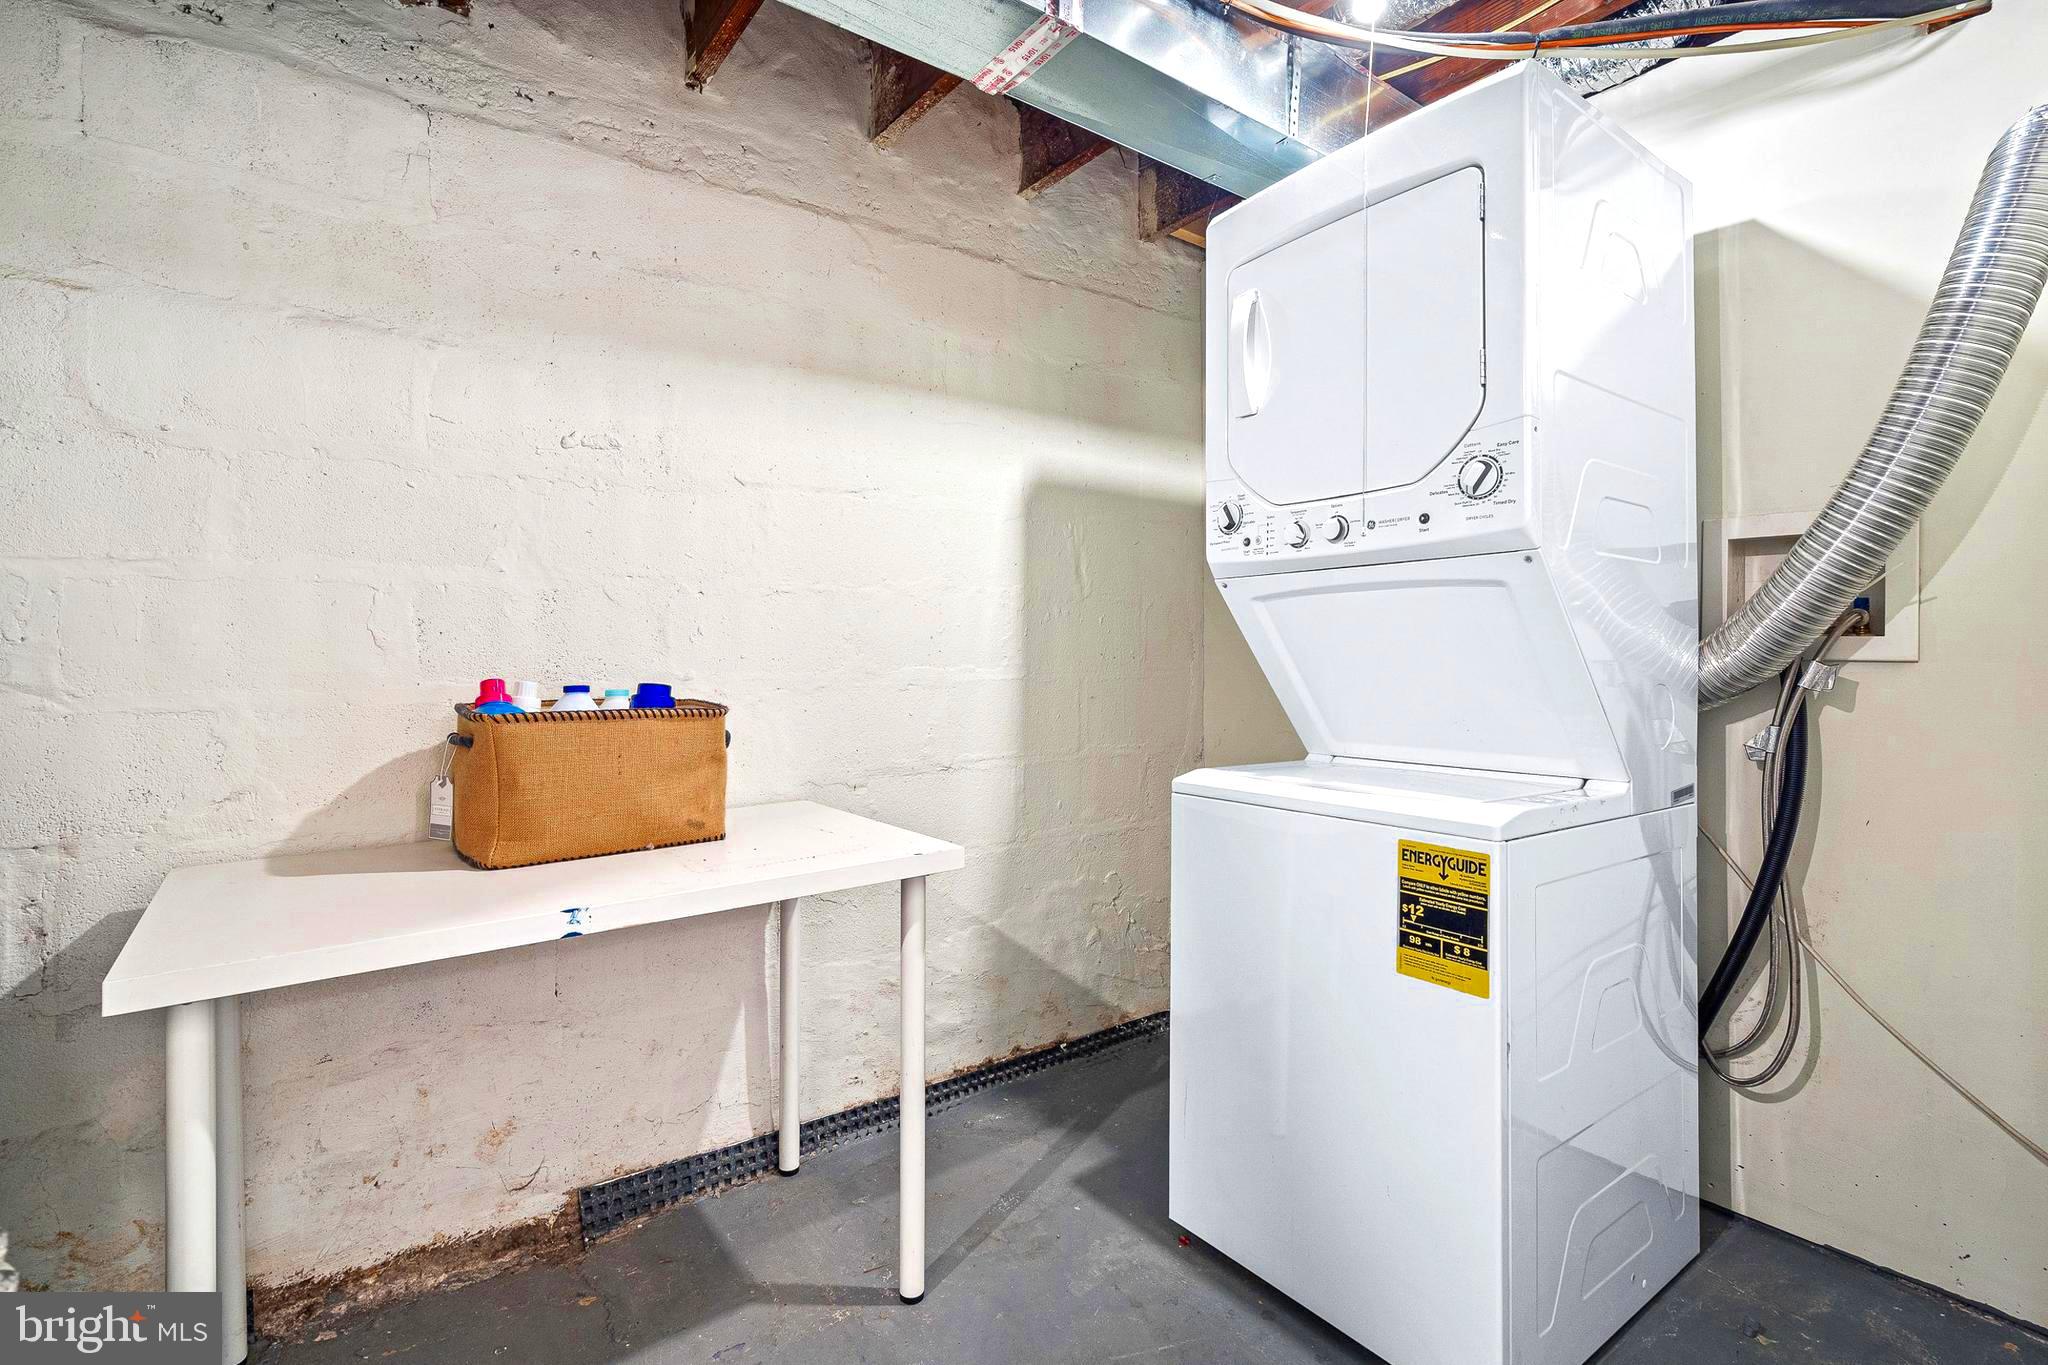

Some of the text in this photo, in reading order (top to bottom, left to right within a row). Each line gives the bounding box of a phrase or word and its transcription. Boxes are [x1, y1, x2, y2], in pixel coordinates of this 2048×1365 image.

[1022, 47, 1039, 61] 10/15
[1402, 848, 1487, 878] ENERGYGUIDE
[1402, 903, 1424, 917] $12
[1409, 935, 1422, 945] 98
